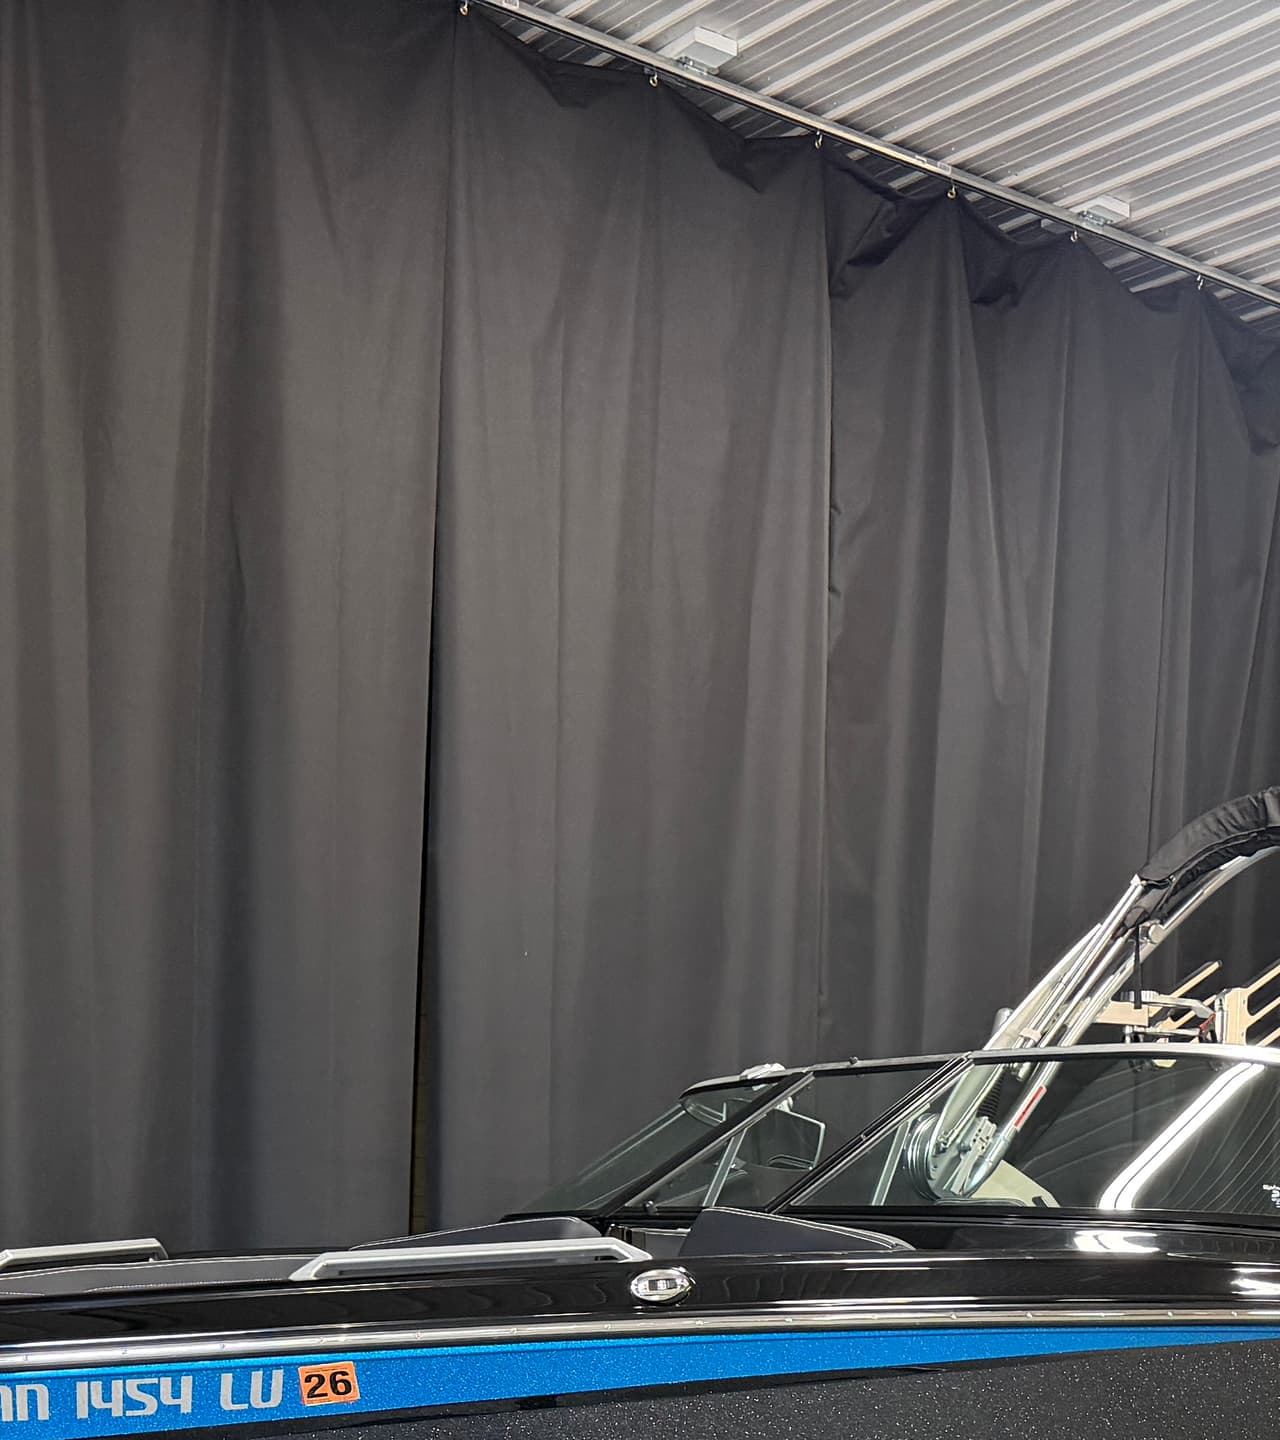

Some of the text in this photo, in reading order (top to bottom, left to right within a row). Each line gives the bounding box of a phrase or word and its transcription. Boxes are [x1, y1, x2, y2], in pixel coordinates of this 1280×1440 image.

[76, 1376, 194, 1419] 1454
[220, 1369, 284, 1411] LU
[304, 1371, 352, 1399] 26
